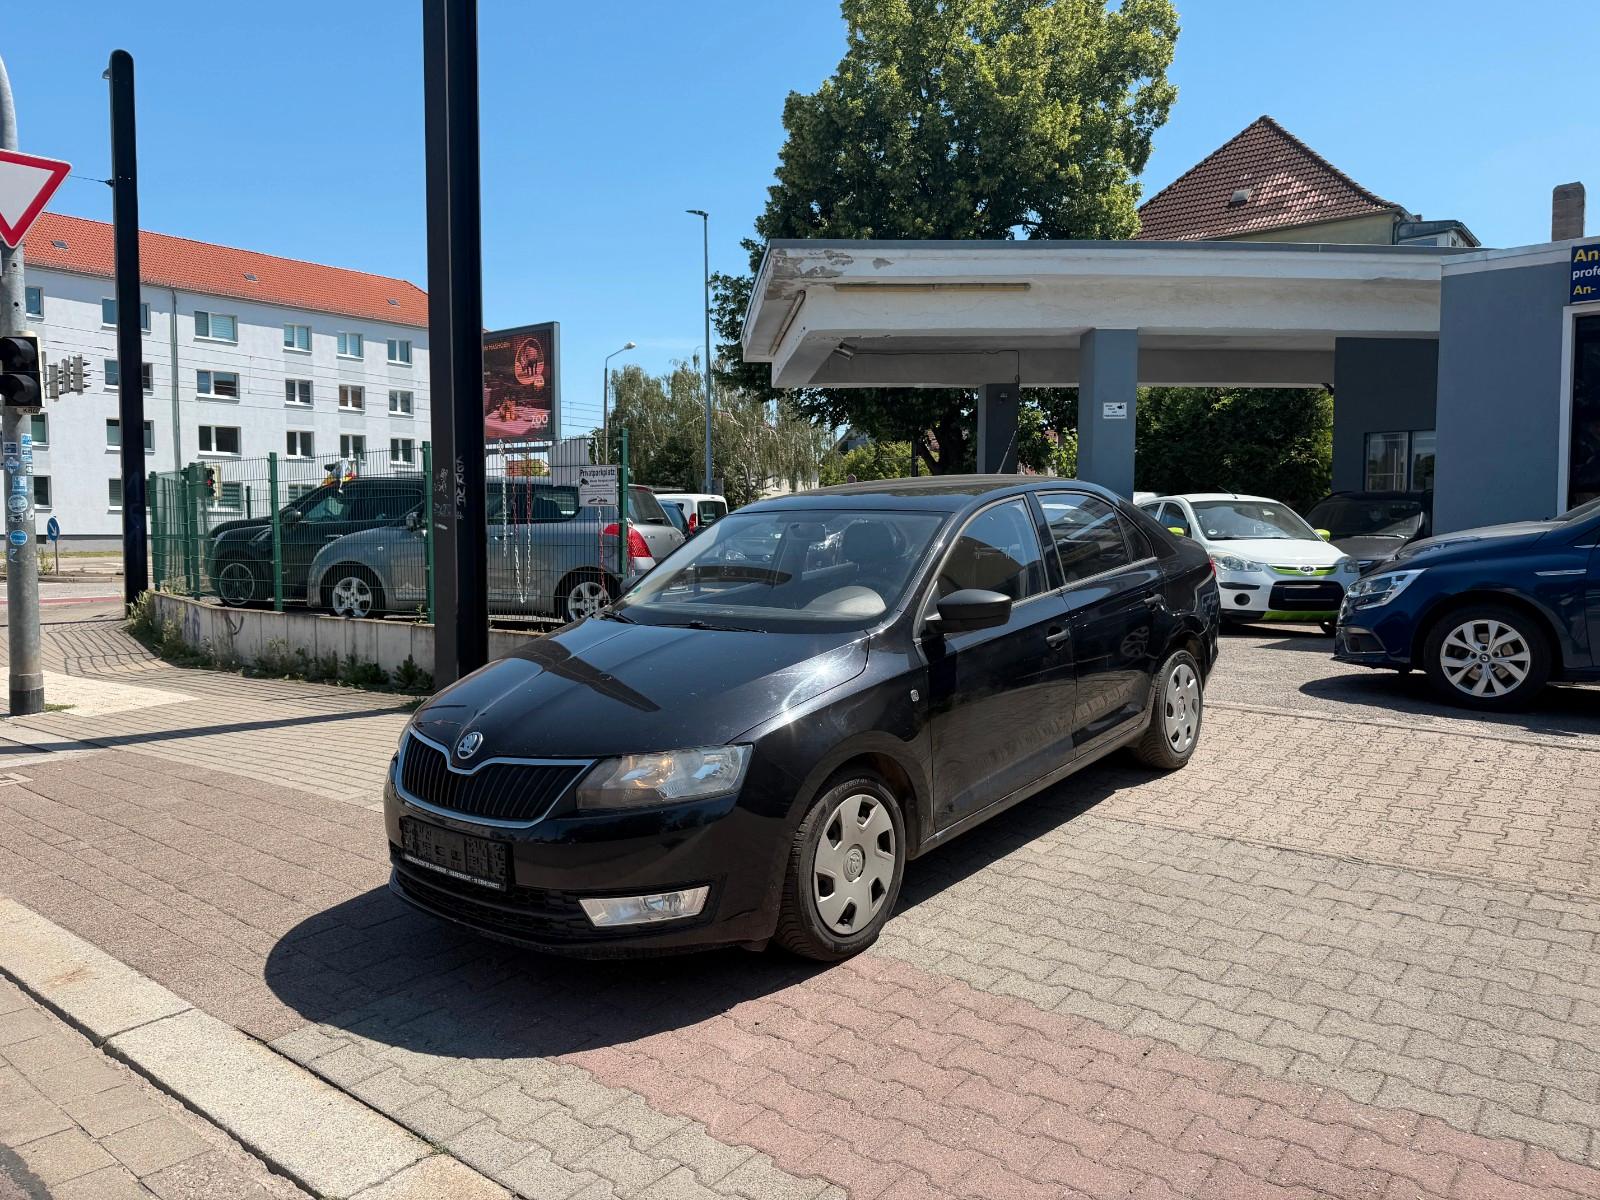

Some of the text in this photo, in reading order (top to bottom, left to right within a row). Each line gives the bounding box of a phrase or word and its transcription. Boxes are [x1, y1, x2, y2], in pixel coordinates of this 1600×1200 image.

[1574, 249, 1600, 262] An
[1573, 285, 1597, 295] An-
[531, 414, 548, 424] ZOO
[580, 467, 616, 478] Privatparkplatz
